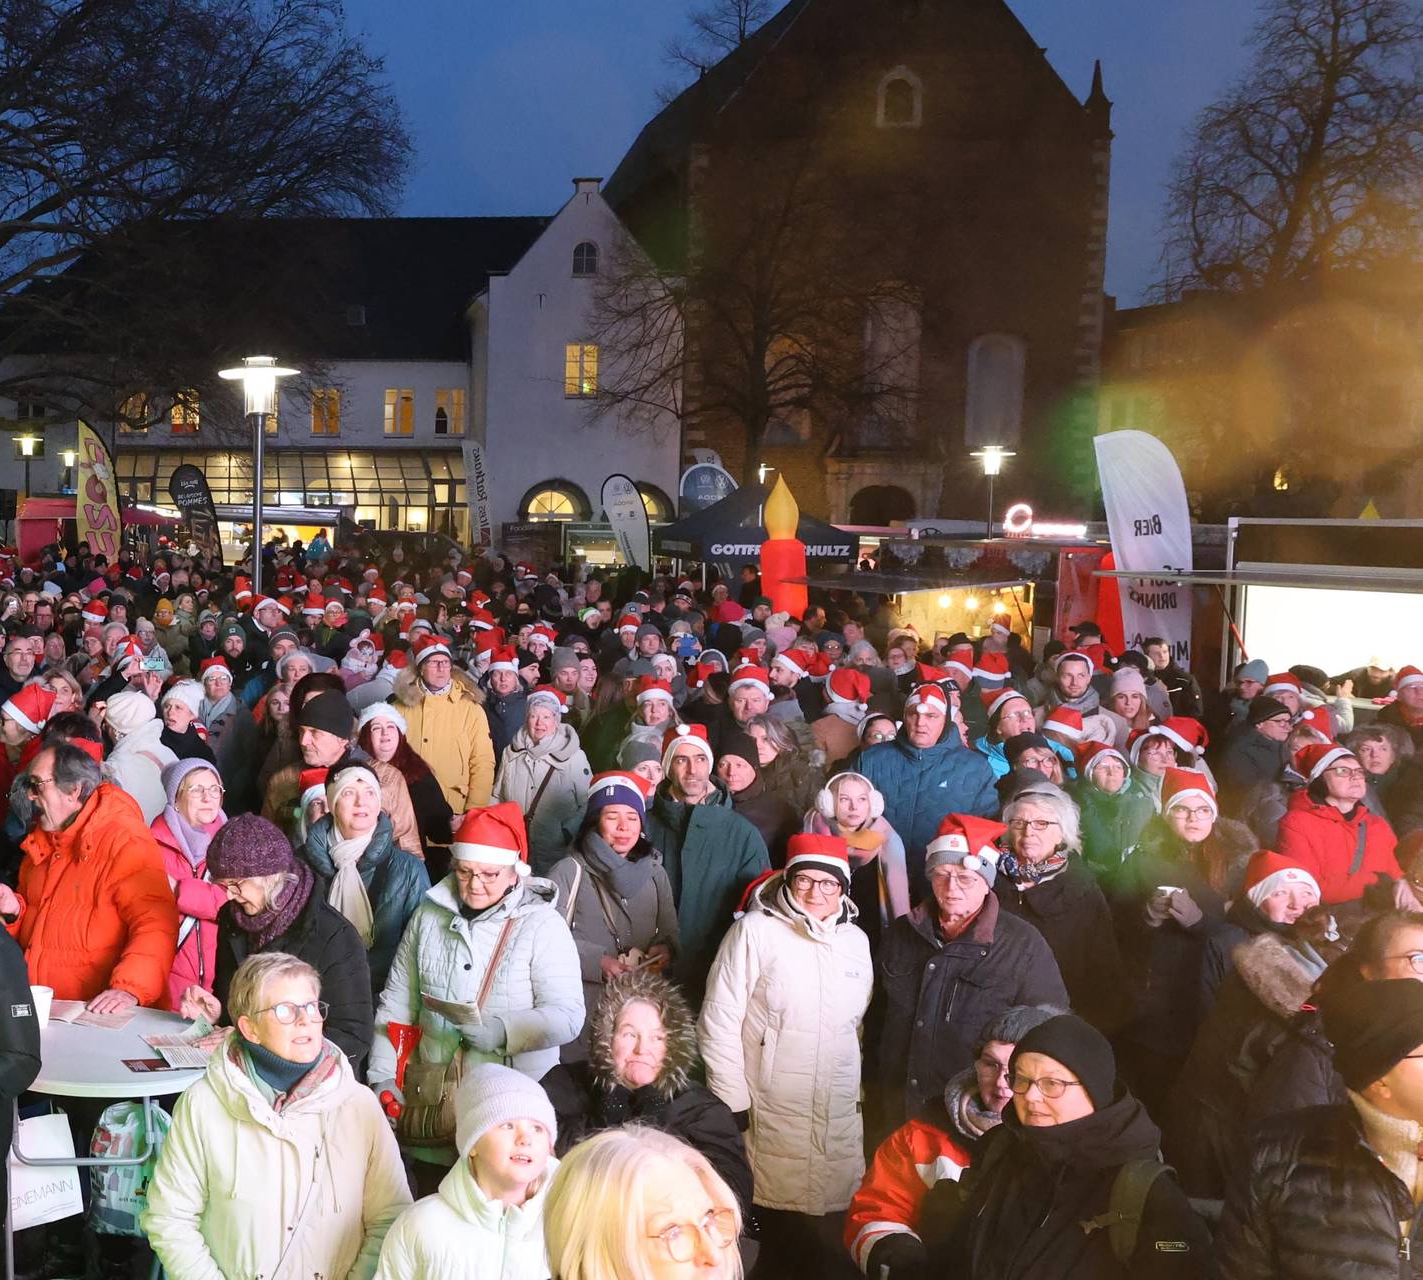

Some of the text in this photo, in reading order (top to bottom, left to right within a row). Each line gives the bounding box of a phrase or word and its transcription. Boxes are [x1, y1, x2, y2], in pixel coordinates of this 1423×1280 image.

[178, 497, 208, 506] POMMES
[710, 543, 850, 557] GOTTFR HULTZ
[11, 1179, 73, 1211] EINEMANN
